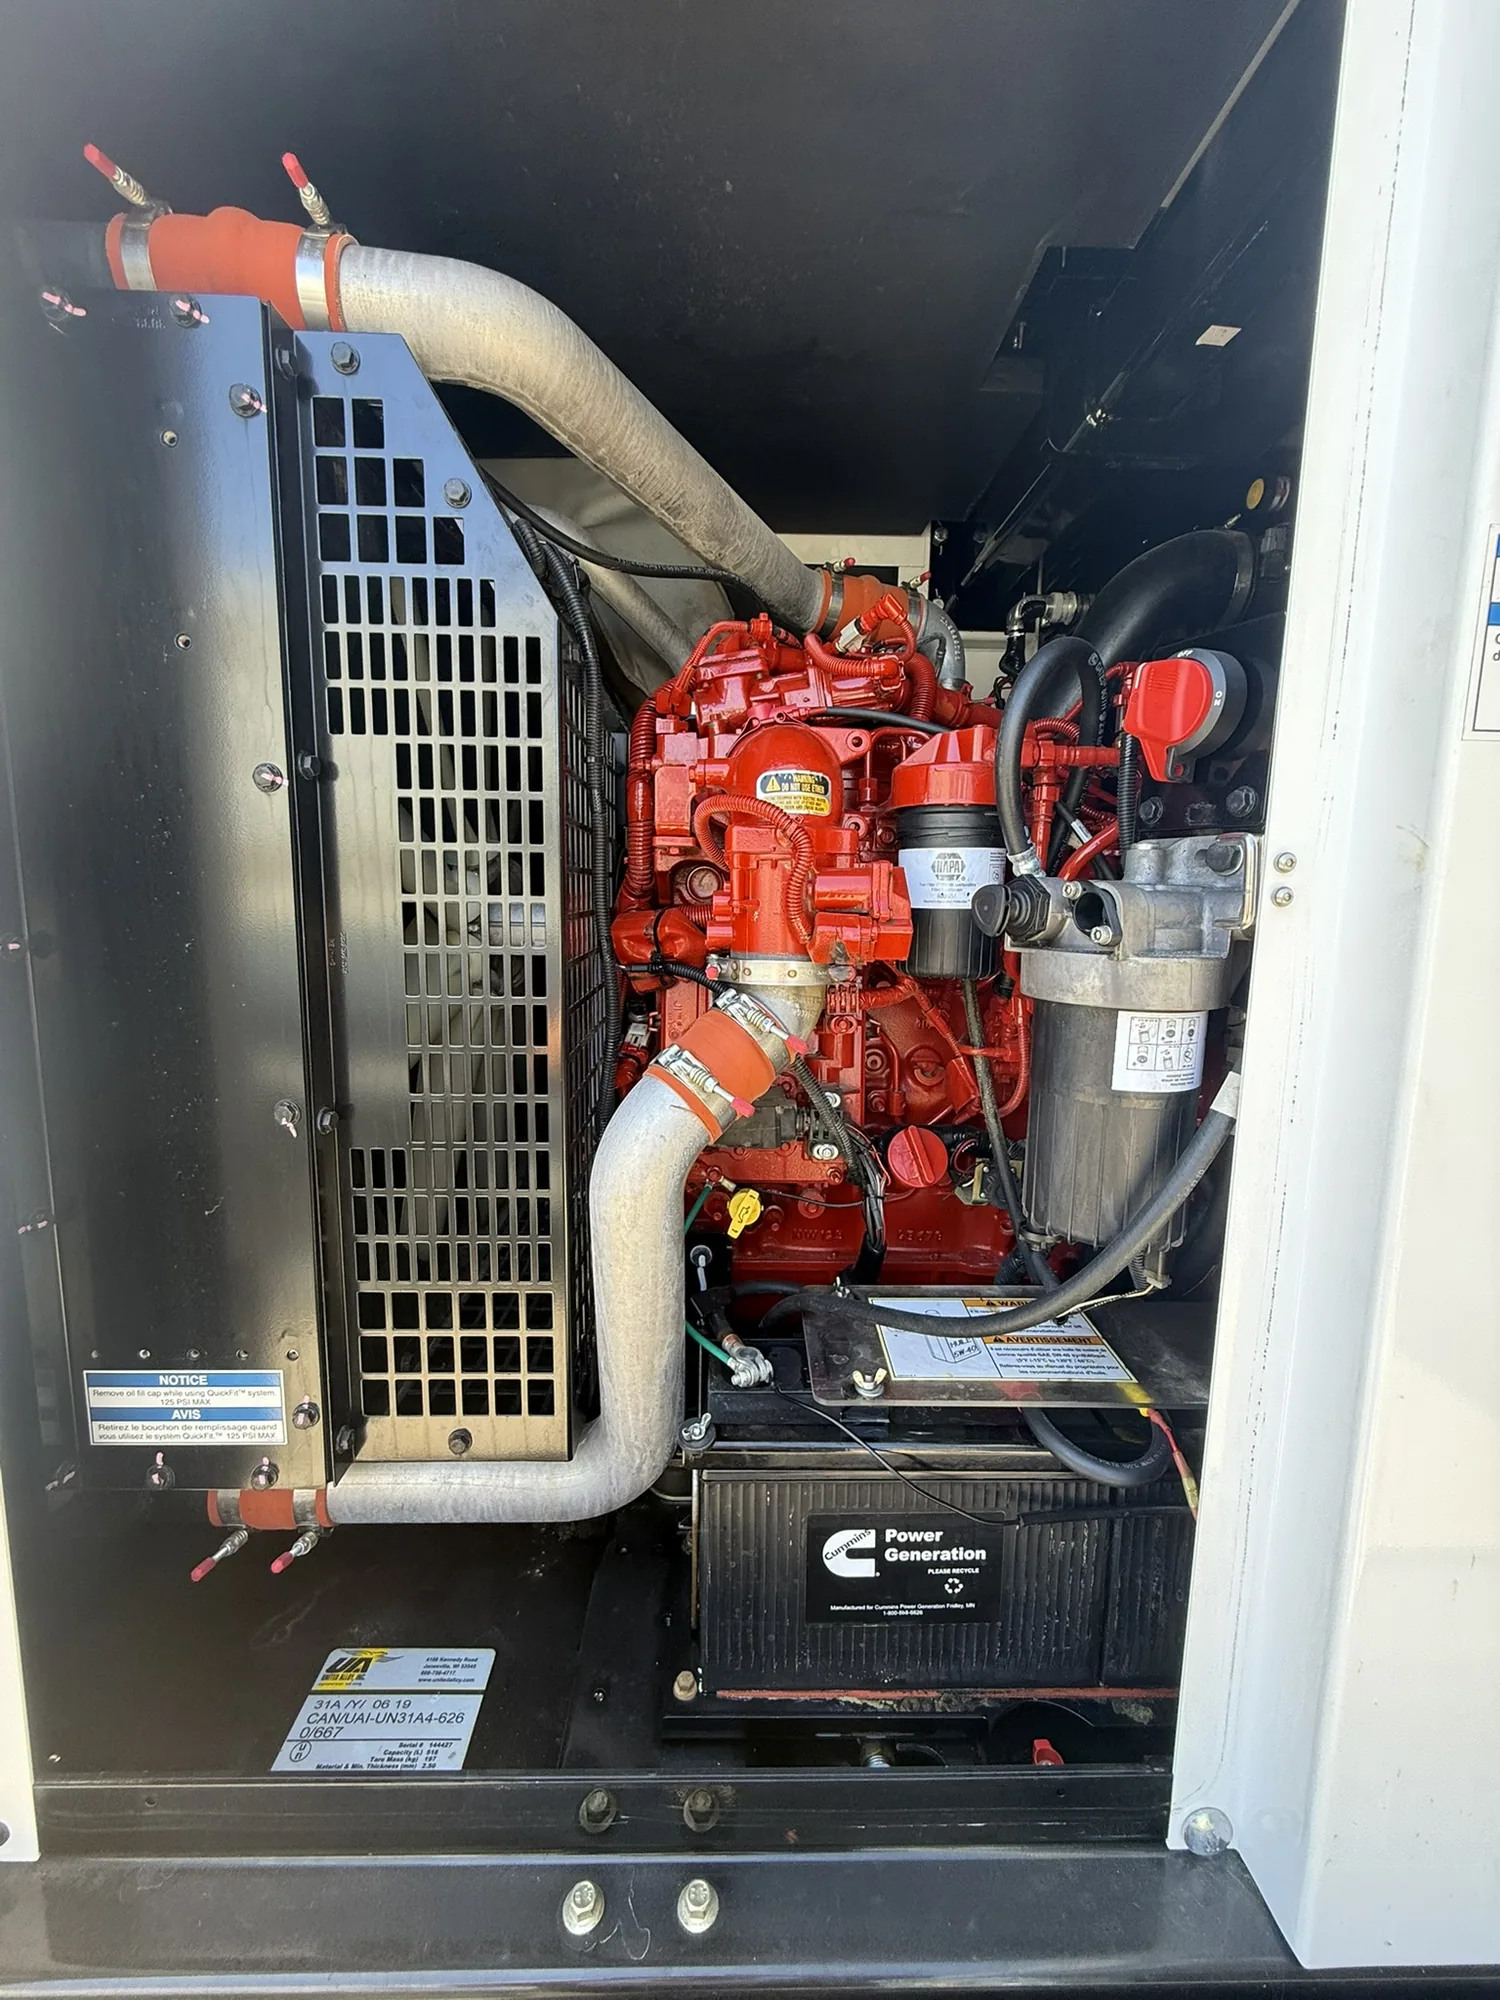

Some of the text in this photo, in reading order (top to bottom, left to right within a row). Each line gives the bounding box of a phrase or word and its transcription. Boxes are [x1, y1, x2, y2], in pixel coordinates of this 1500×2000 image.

[1176, 649, 1194, 658] OFF
[1213, 690, 1223, 707] ON
[936, 860, 961, 874] NAPA
[1006, 1336, 1092, 1344] AVERTISSEMENT
[953, 1345, 977, 1358] 5W-40
[158, 1374, 209, 1386] NOTICE
[92, 1389, 125, 1397] Remove
[126, 1389, 136, 1397] oil
[136, 1389, 146, 1397] fill
[146, 1390, 162, 1398] cap
[163, 1389, 183, 1397] while
[184, 1389, 206, 1398] using
[247, 1390, 278, 1399] system.
[160, 1398, 212, 1406] 125 PSI MAX
[171, 1408, 202, 1420] AVIS
[98, 1423, 278, 1432] Retirez le bouchon de remplissage quand
[117, 1432, 144, 1440] utilisez
[145, 1432, 153, 1440] le
[226, 1432, 241, 1440] 125
[242, 1432, 256, 1440] PSI
[885, 1528, 944, 1543] Power
[824, 1529, 872, 1561] Cummins
[884, 1546, 987, 1562] Generation
[325, 1657, 374, 1673] UA
[313, 1699, 412, 1710] 31A /Y/ 06 19
[306, 1712, 465, 1725] CAN/UAI-UN31A4-626
[299, 1726, 345, 1739] 0/667
[383, 1749, 413, 1757] Capacity
